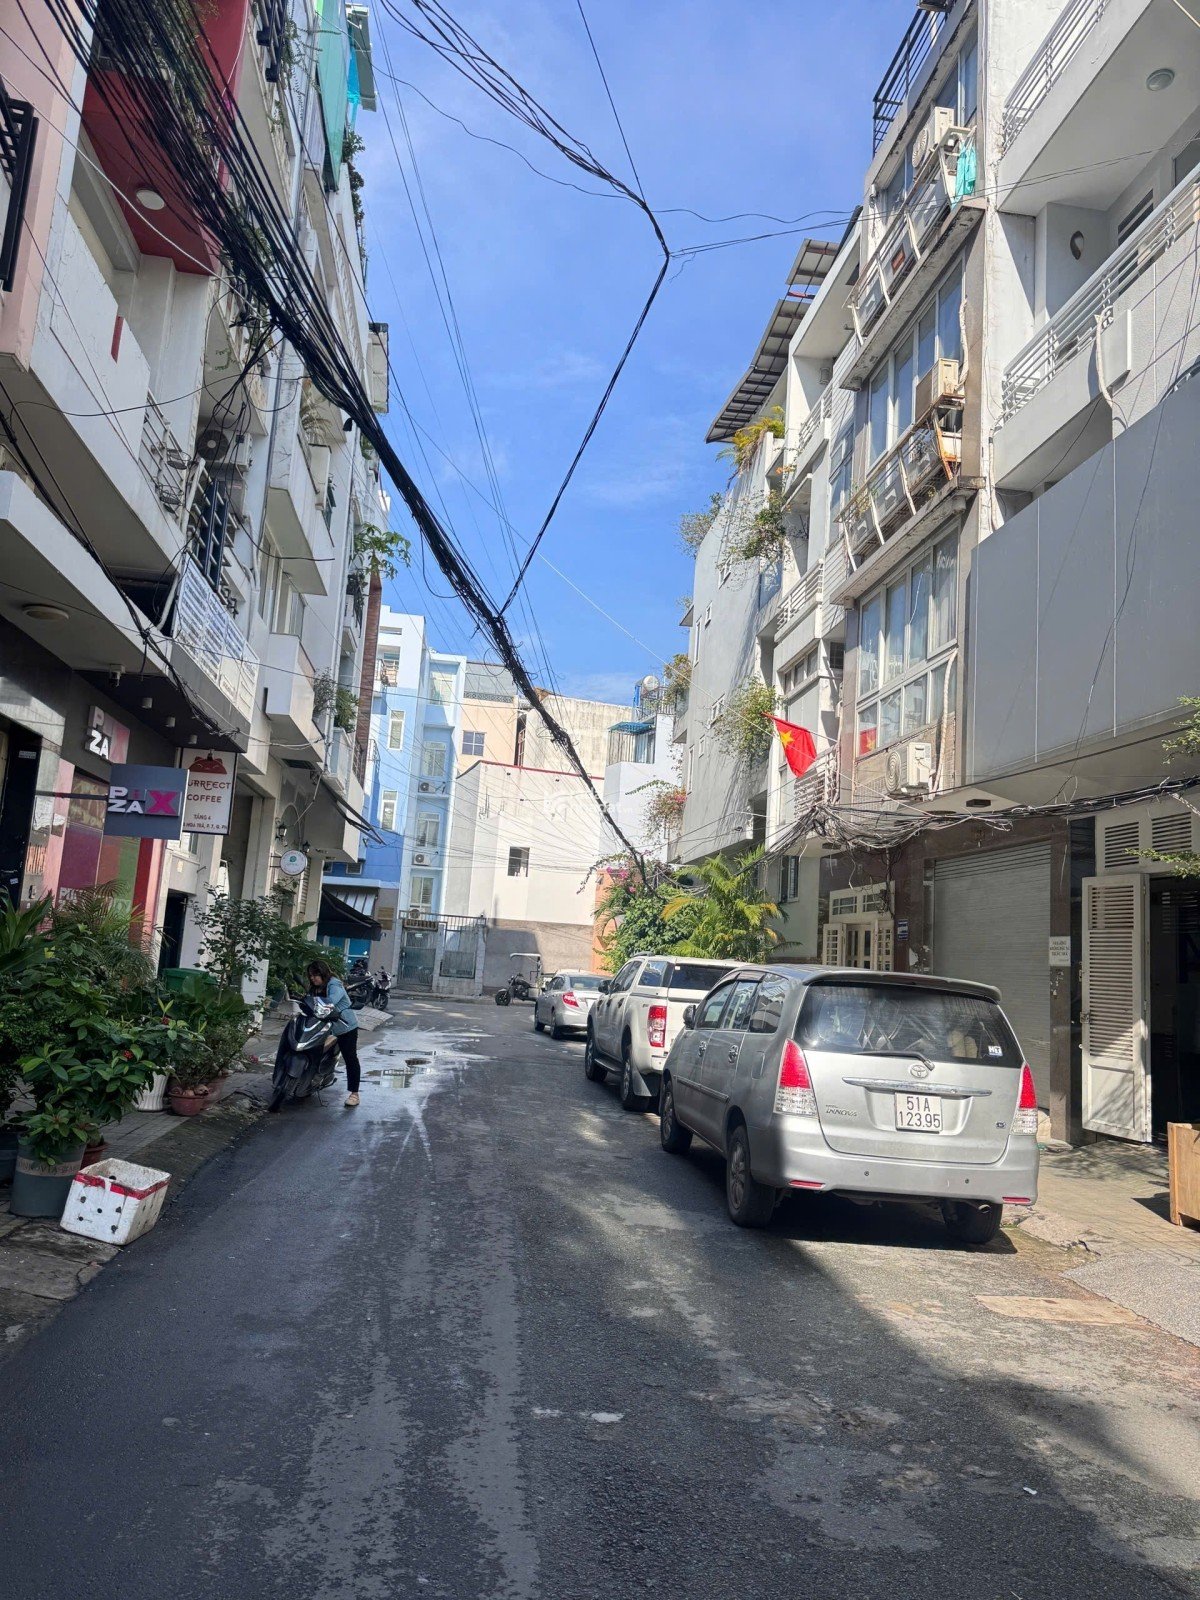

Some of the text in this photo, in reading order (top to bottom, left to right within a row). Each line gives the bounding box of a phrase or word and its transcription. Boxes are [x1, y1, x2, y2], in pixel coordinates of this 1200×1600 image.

[89, 729, 109, 760] ZA
[188, 780, 231, 790] URRFECT
[187, 793, 222, 803] COFFEE
[107, 799, 144, 814] ZA
[906, 1096, 930, 1112] 51A
[898, 1112, 941, 1128] 123.95
